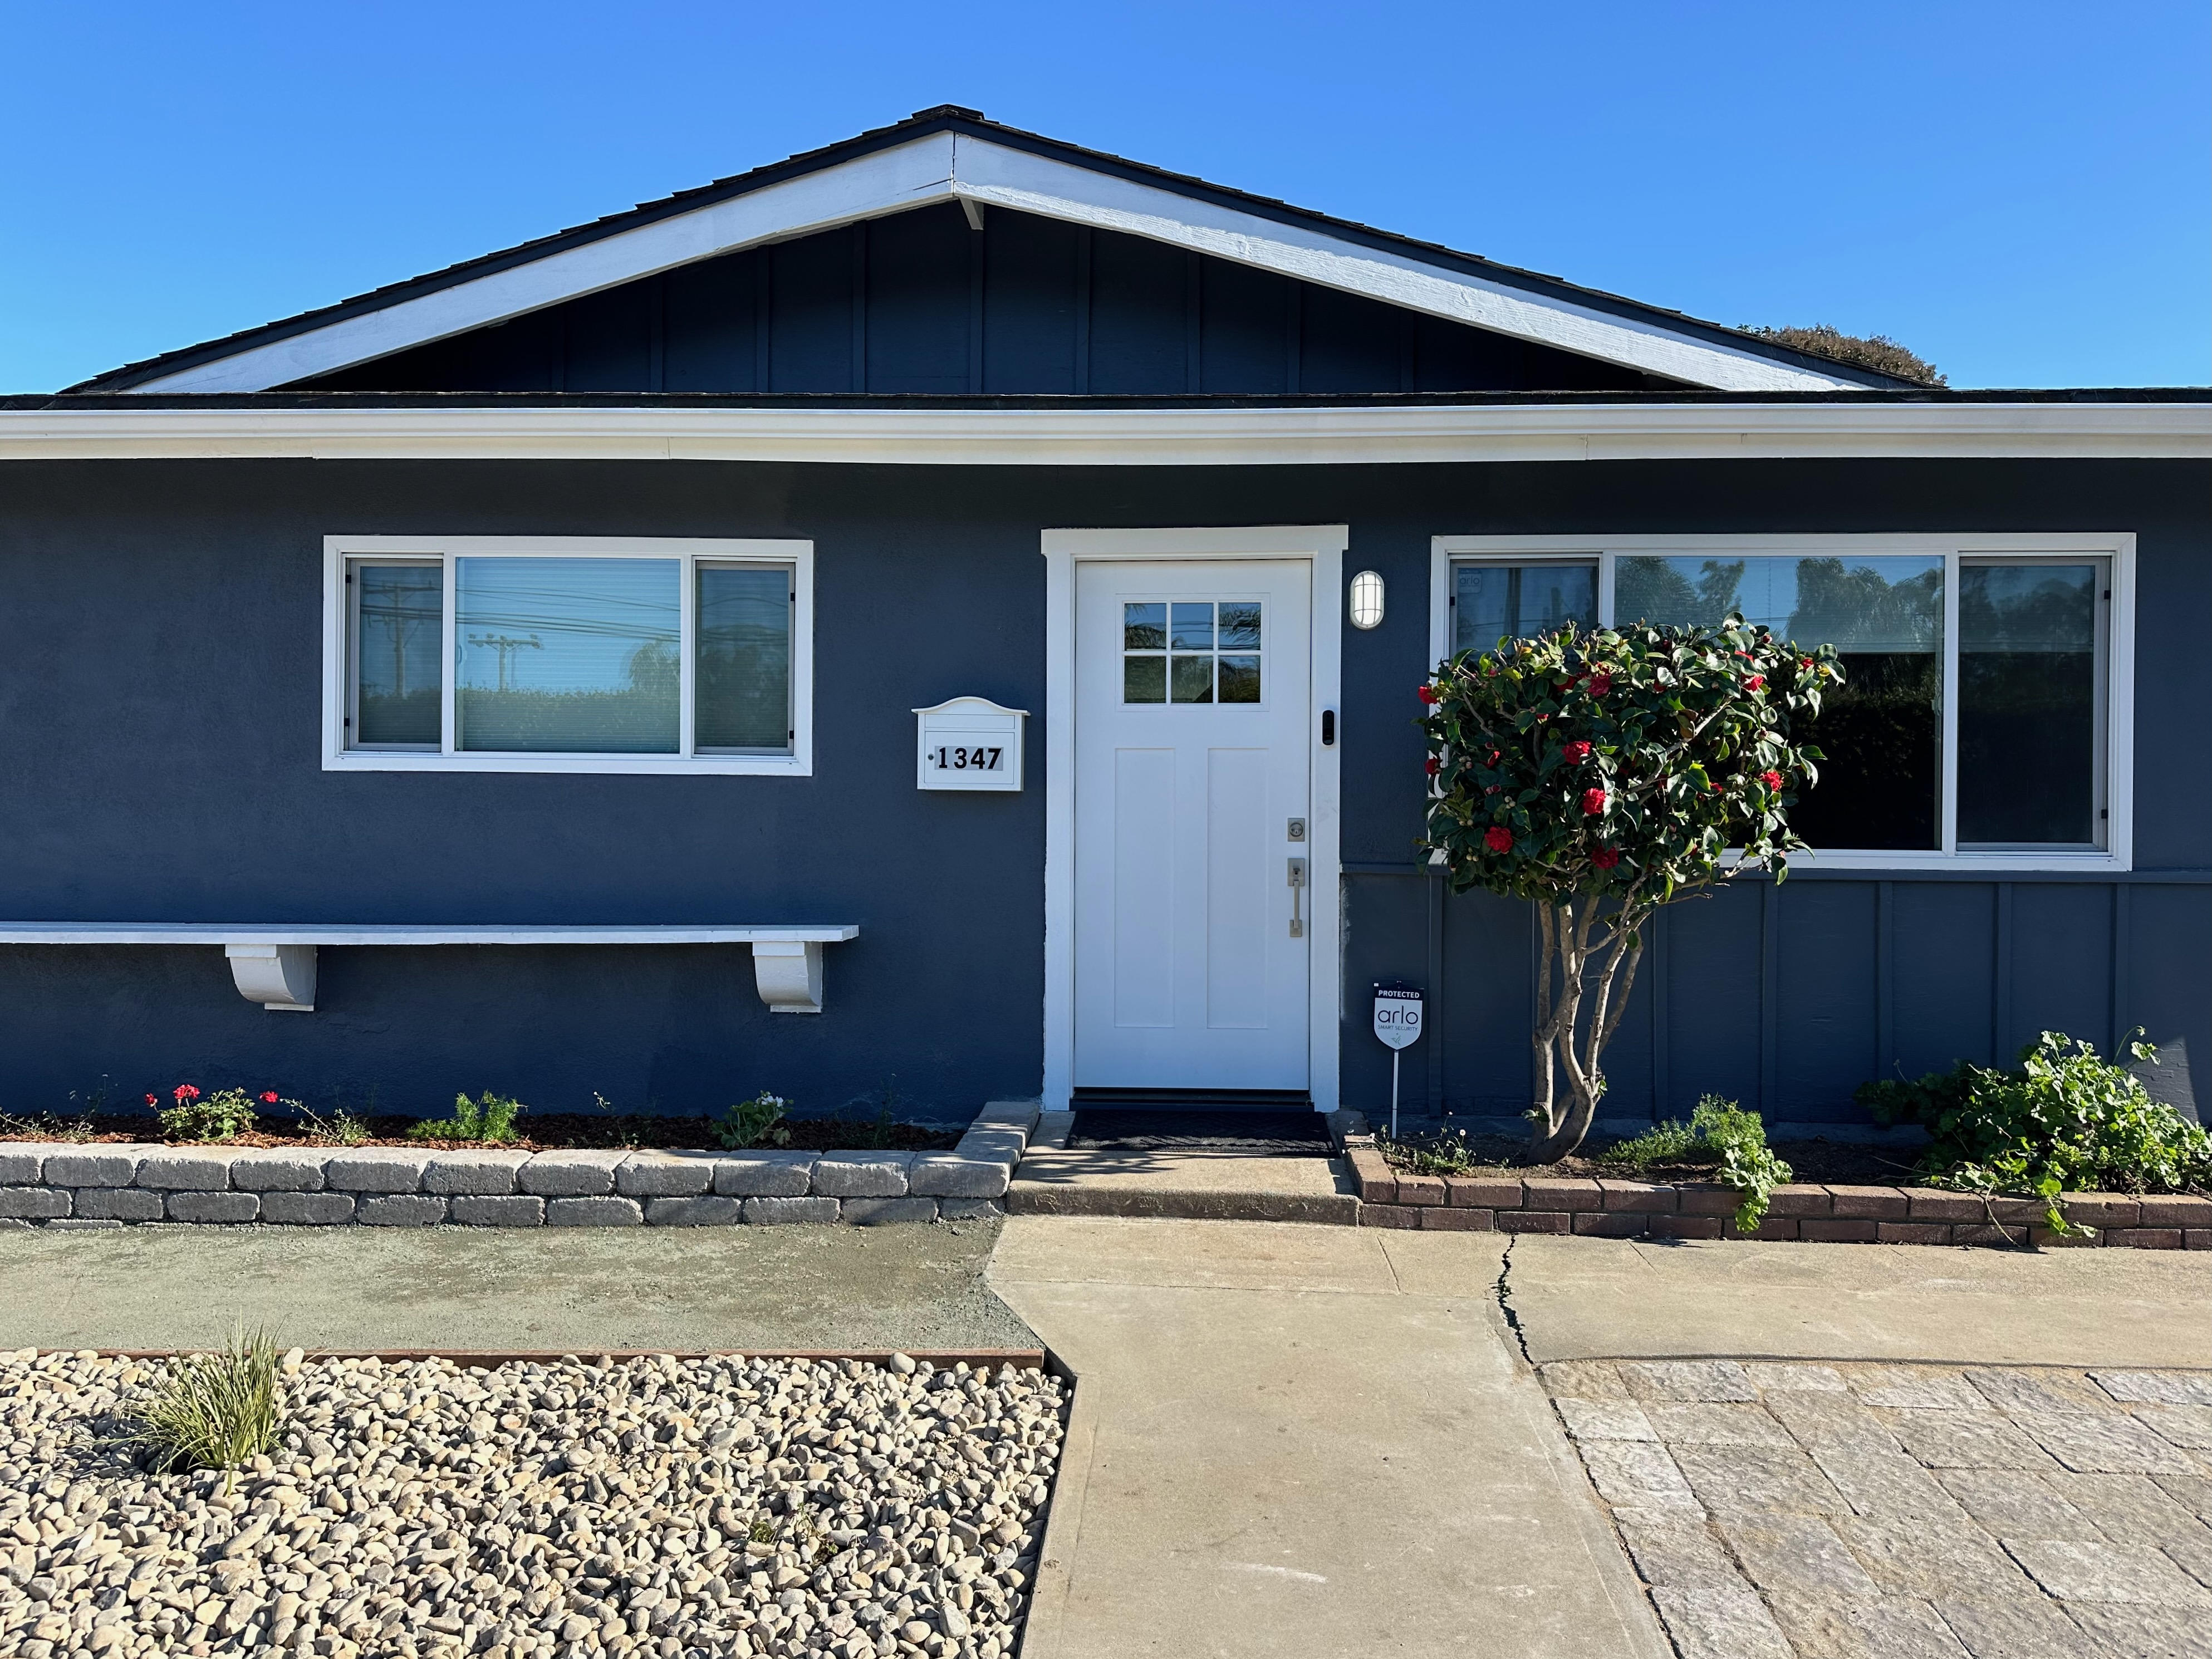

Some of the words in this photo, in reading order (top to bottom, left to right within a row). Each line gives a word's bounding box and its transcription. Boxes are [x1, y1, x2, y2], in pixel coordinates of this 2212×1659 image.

[1459, 575, 1480, 584] arlo
[939, 747, 1002, 769] 1347
[1378, 990, 1420, 998] PROTECTED
[1377, 1005, 1418, 1024] arlo
